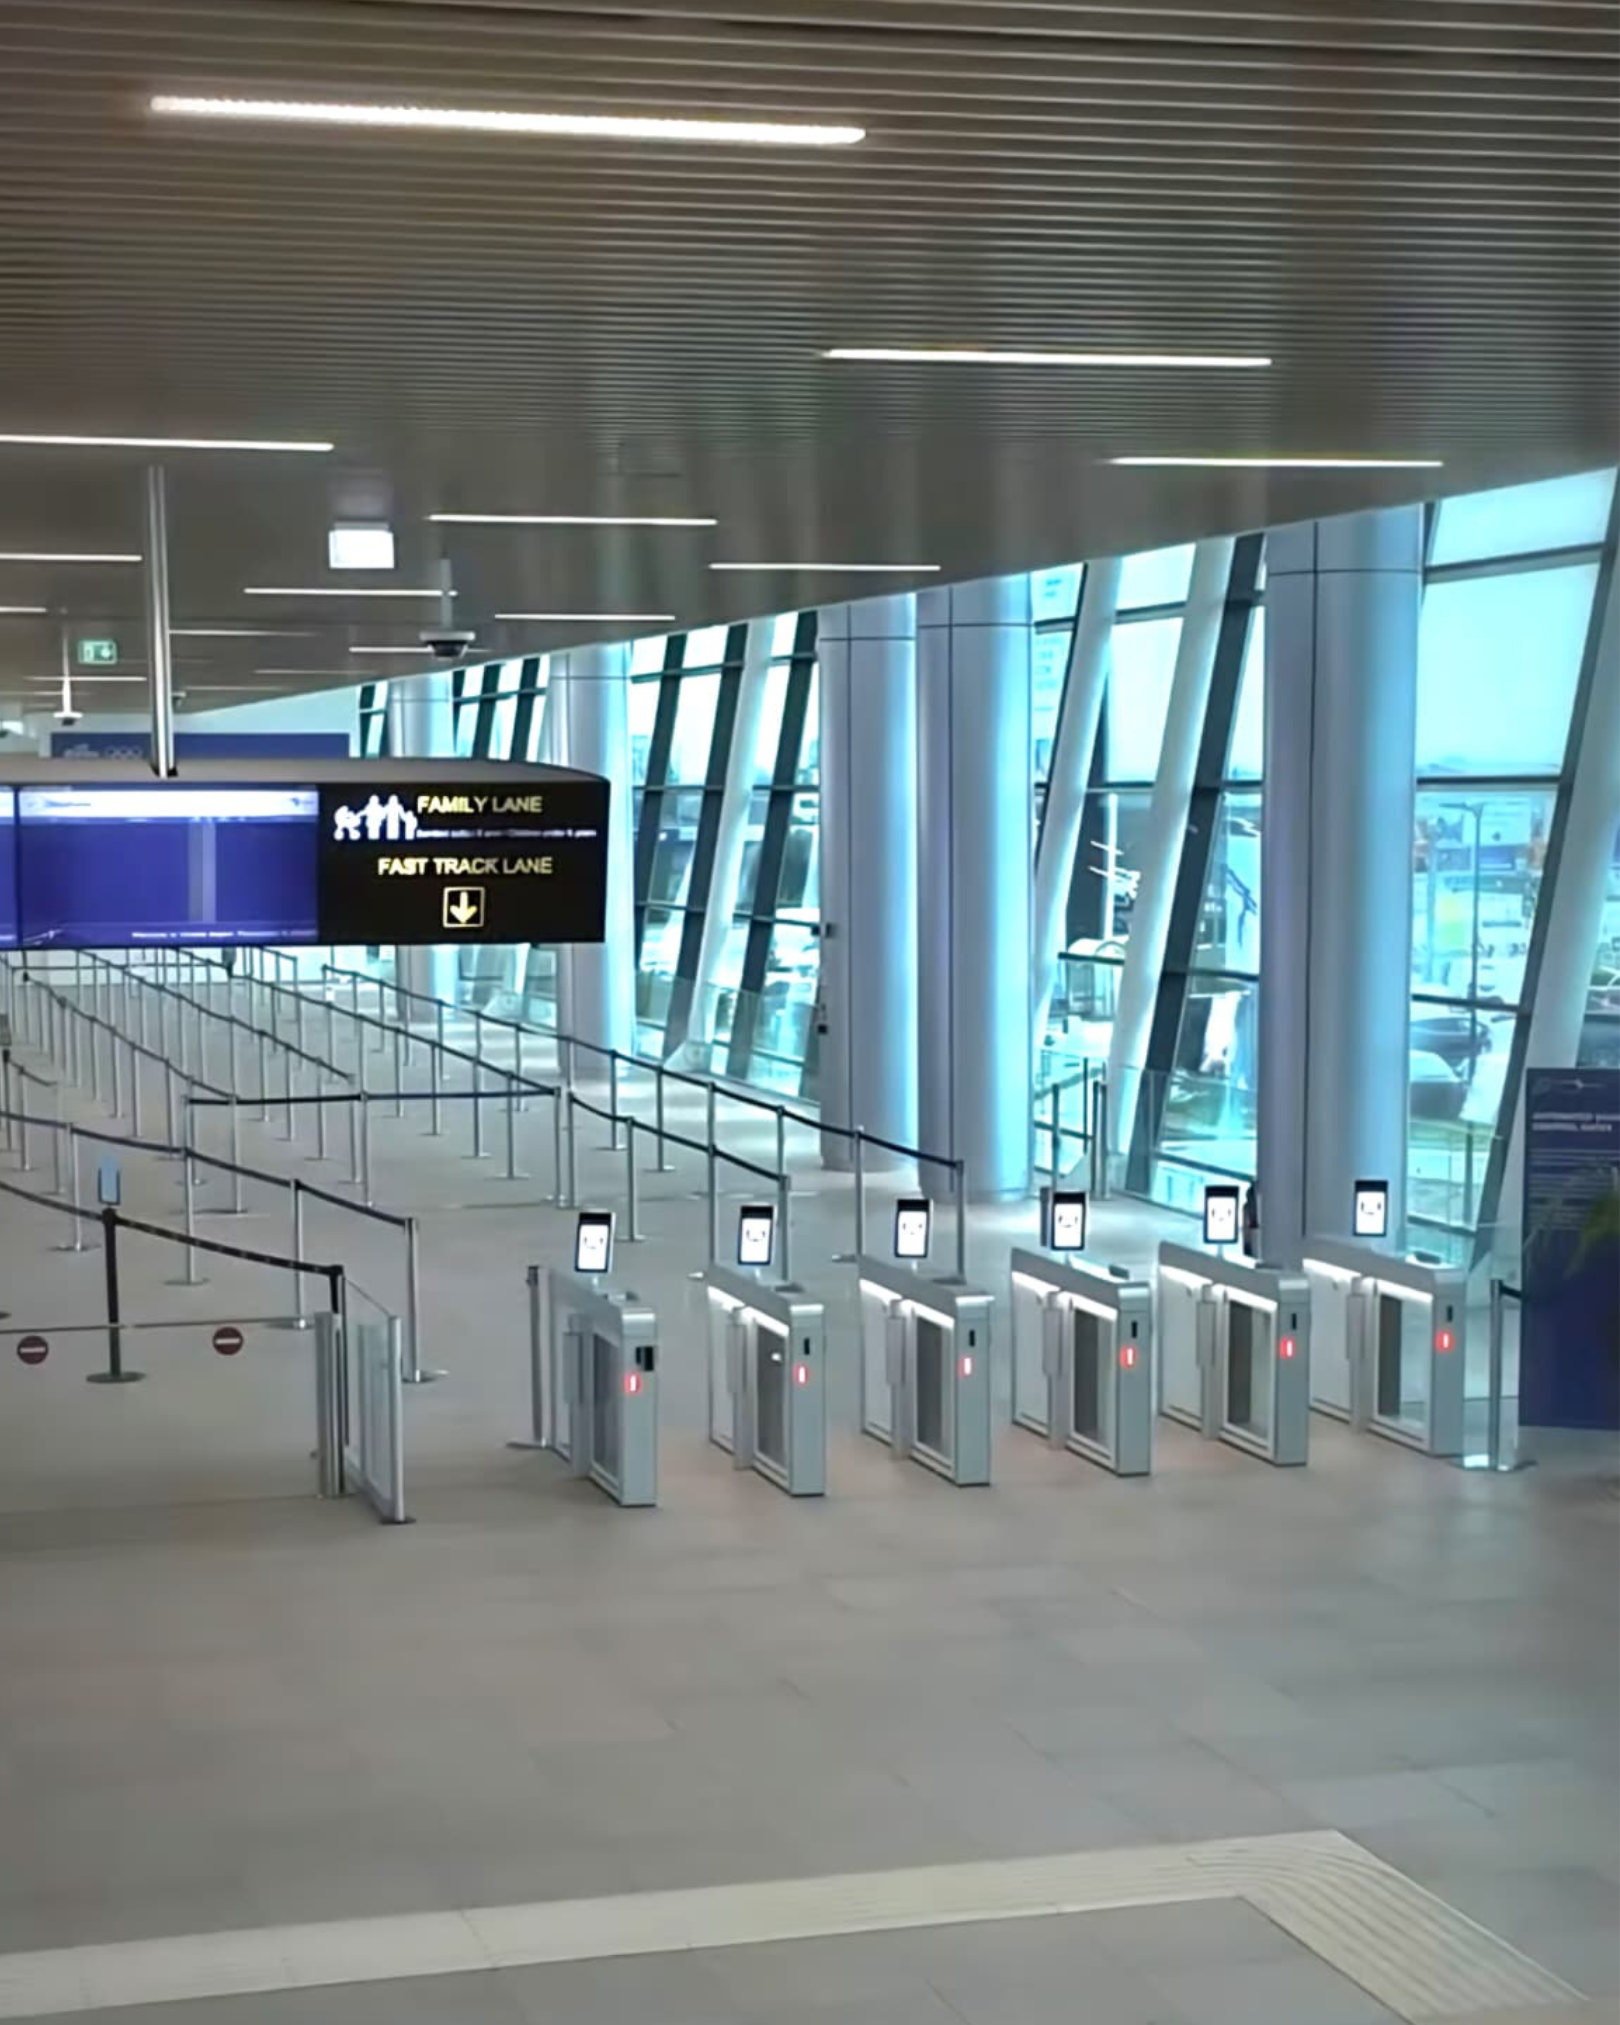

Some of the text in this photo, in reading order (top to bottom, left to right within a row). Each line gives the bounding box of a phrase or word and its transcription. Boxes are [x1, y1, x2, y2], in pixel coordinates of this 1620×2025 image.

[416, 796, 542, 813] FAMILY LANE
[377, 857, 553, 875] FAST TRACK LANE
